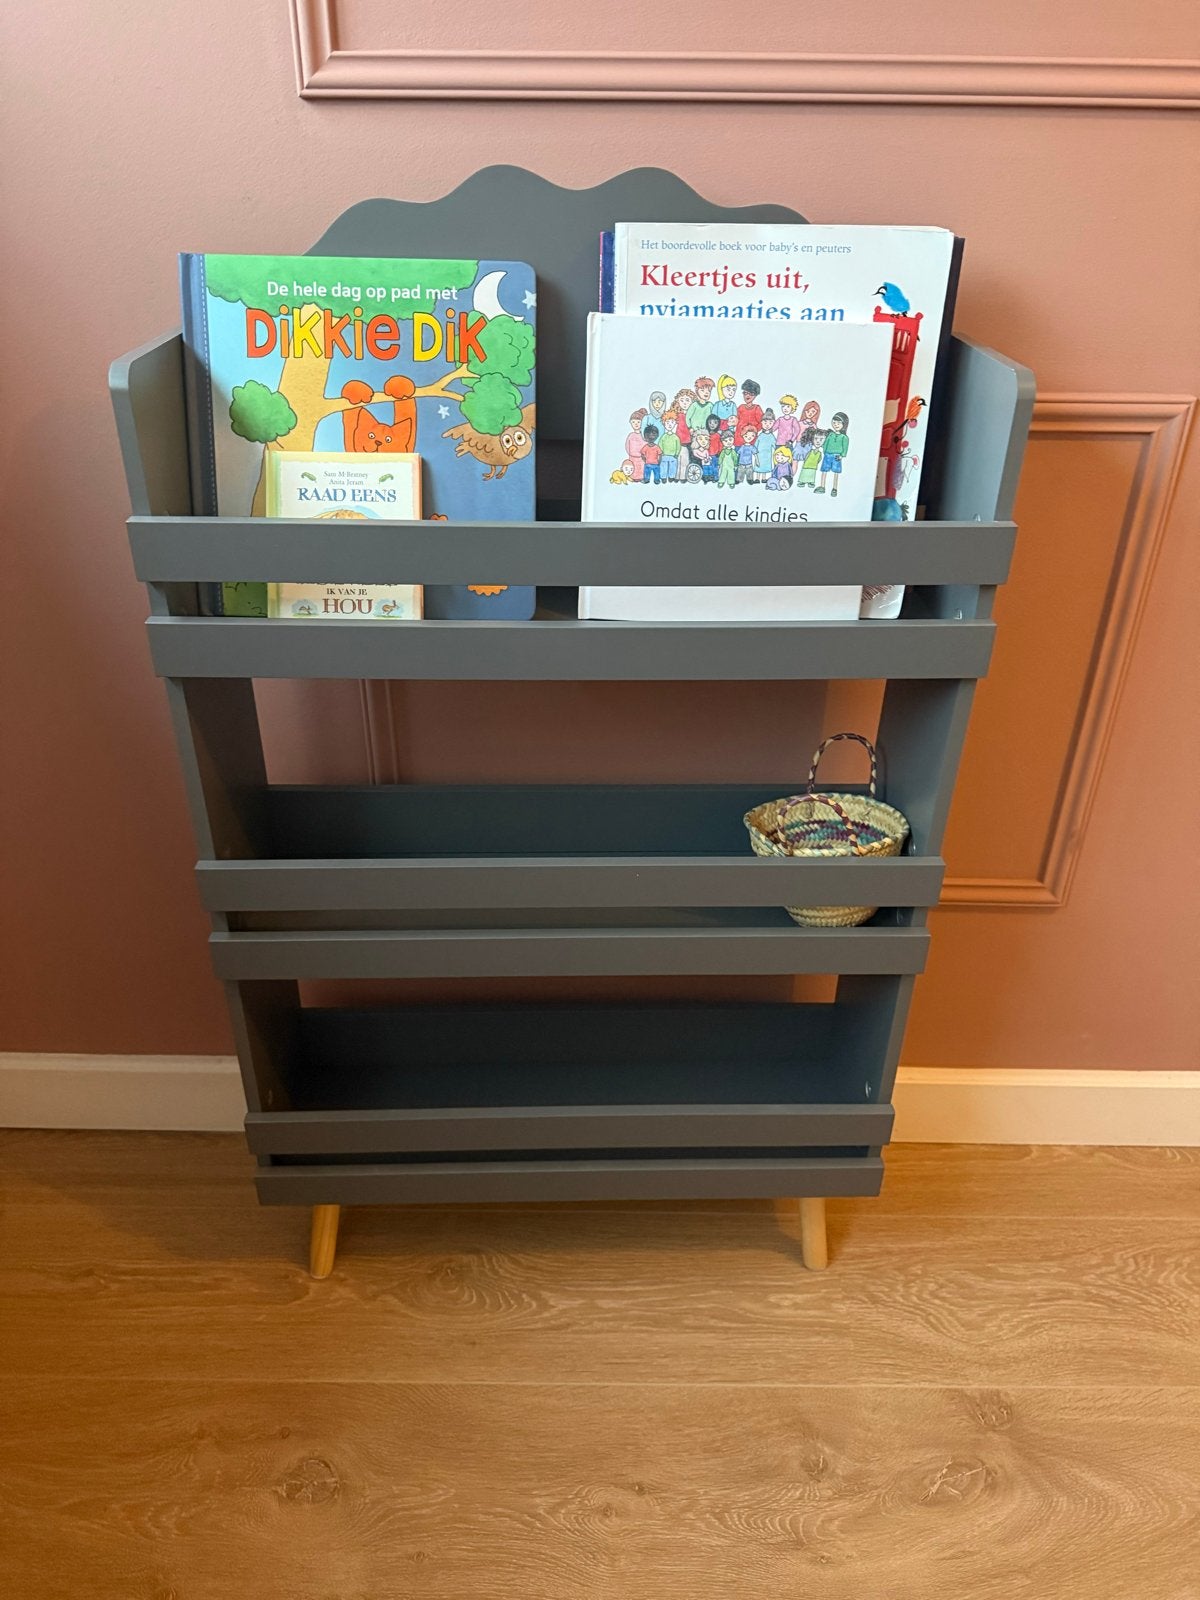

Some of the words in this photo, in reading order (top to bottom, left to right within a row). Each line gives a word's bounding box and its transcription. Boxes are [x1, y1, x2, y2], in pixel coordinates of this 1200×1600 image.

[641, 240, 659, 250] Het
[661, 240, 717, 251] boordevolle
[719, 241, 742, 251] boek
[745, 243, 767, 251] voor
[769, 241, 799, 254] baby's
[800, 244, 813, 252] en
[815, 244, 852, 255] peuters
[640, 264, 757, 295] Kleertjes
[766, 267, 810, 293] uit,
[267, 281, 289, 296] De
[293, 281, 327, 297] hele
[331, 282, 361, 301] dag
[366, 287, 387, 301] op
[391, 284, 421, 301] pad
[426, 285, 458, 300] met
[800, 307, 845, 321] aan
[297, 487, 347, 502] RAAD
[350, 488, 397, 502] EENS
[640, 500, 700, 520] Omdat
[706, 504, 739, 521] alle
[322, 598, 374, 614] HOU
